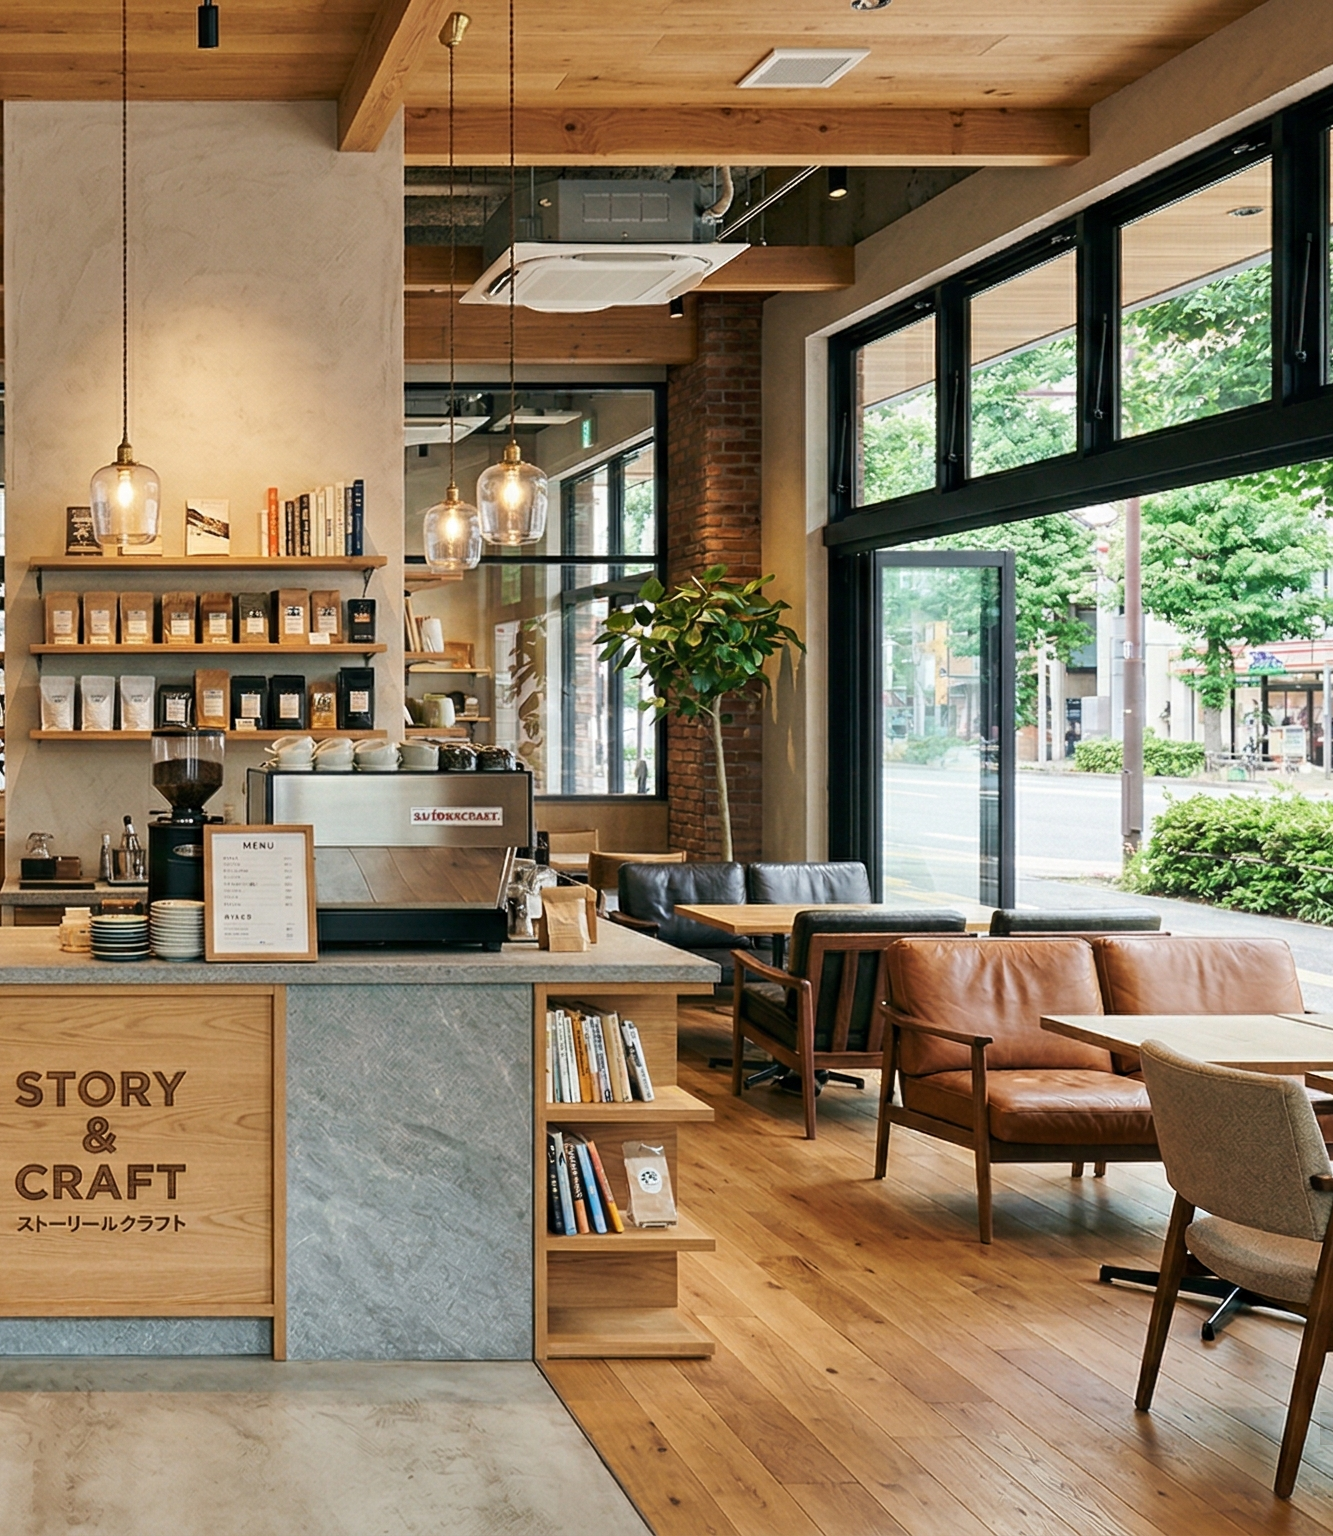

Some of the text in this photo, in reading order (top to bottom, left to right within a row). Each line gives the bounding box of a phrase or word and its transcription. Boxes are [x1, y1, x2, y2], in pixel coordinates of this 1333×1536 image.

[242, 841, 275, 850] MENU
[15, 1070, 187, 1107] STORY
[82, 1116, 117, 1154] &
[15, 1164, 187, 1200] CRAFT
[17, 1215, 187, 1233] ストーリールクラフト
